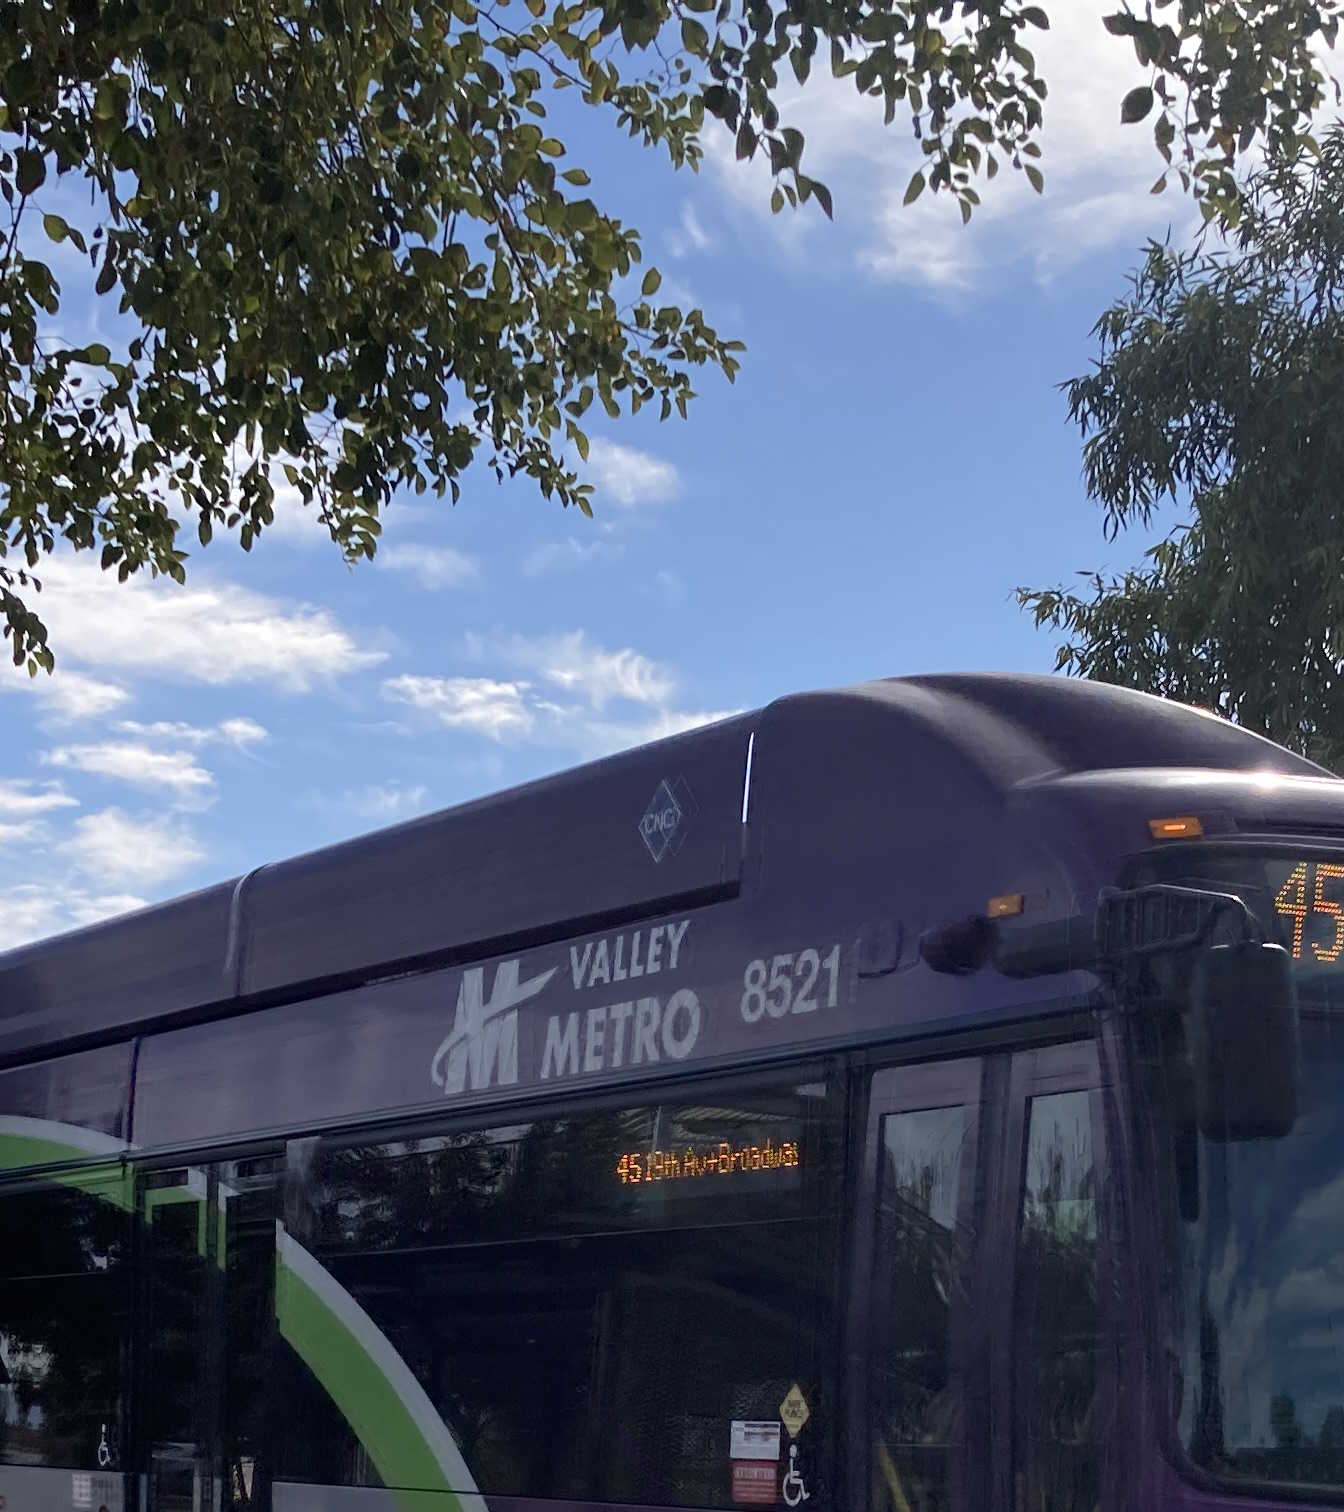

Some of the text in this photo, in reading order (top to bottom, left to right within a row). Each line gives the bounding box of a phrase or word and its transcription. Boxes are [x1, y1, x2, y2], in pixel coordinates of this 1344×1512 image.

[1274, 862, 1344, 961] 45
[569, 919, 690, 990] VALLEY
[741, 944, 841, 1023] 8521
[540, 988, 700, 1079] METRO
[616, 1153, 642, 1183] 45
